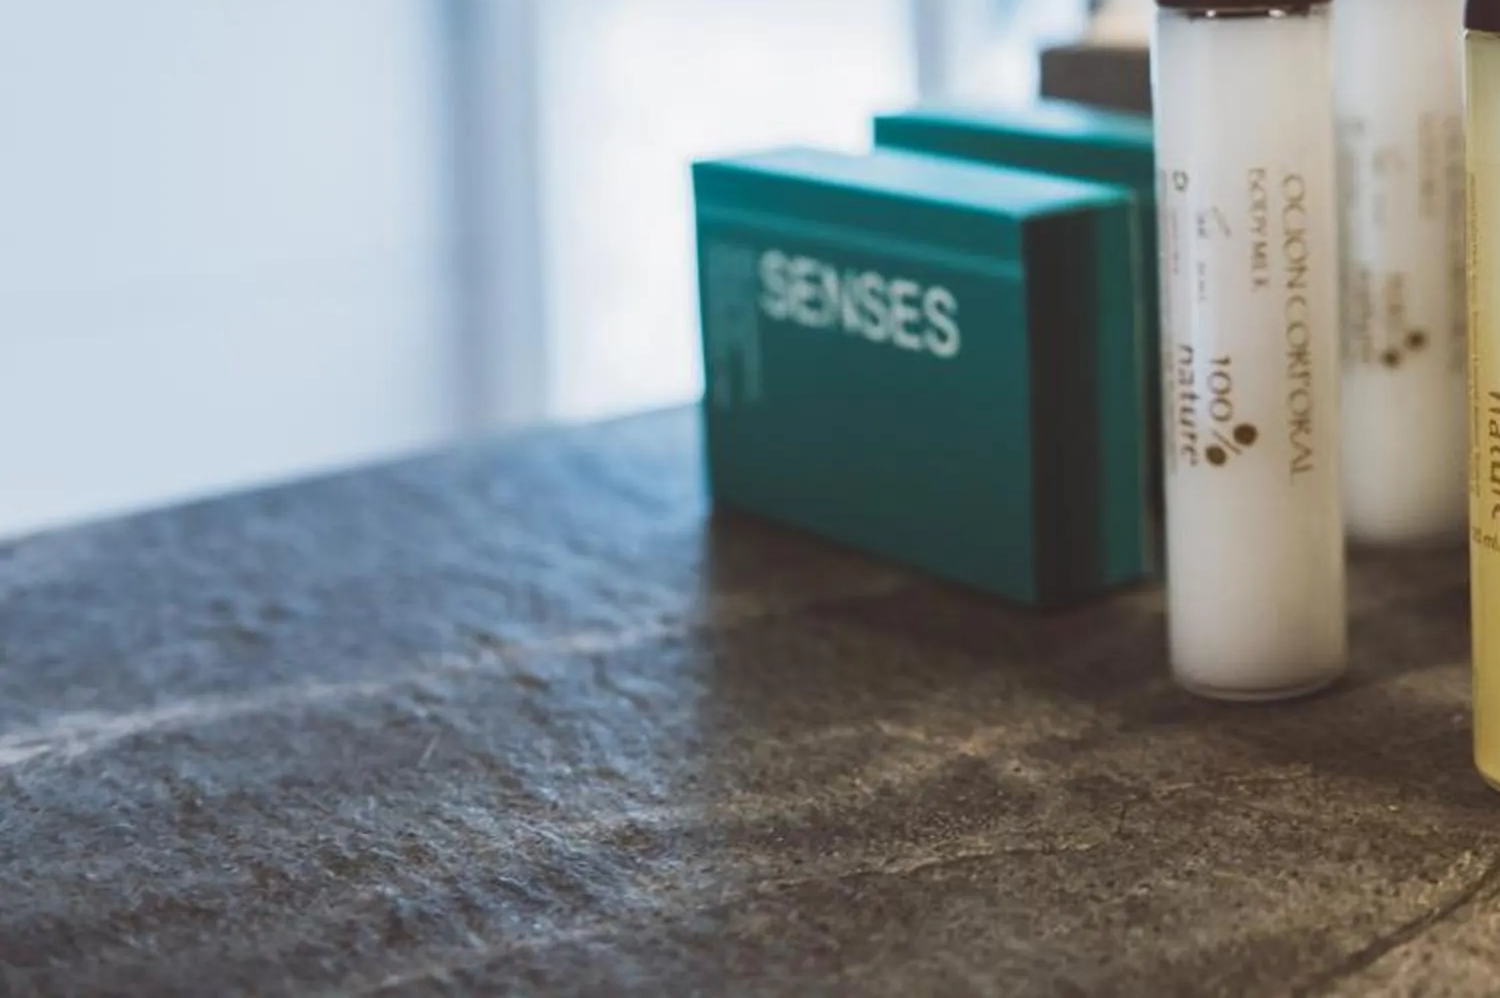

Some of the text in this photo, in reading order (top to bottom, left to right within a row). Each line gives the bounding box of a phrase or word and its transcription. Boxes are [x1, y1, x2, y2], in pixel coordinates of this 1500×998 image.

[758, 248, 961, 358] SENSES
[1178, 343, 1200, 466] nature
[1206, 355, 1258, 467] 100%
